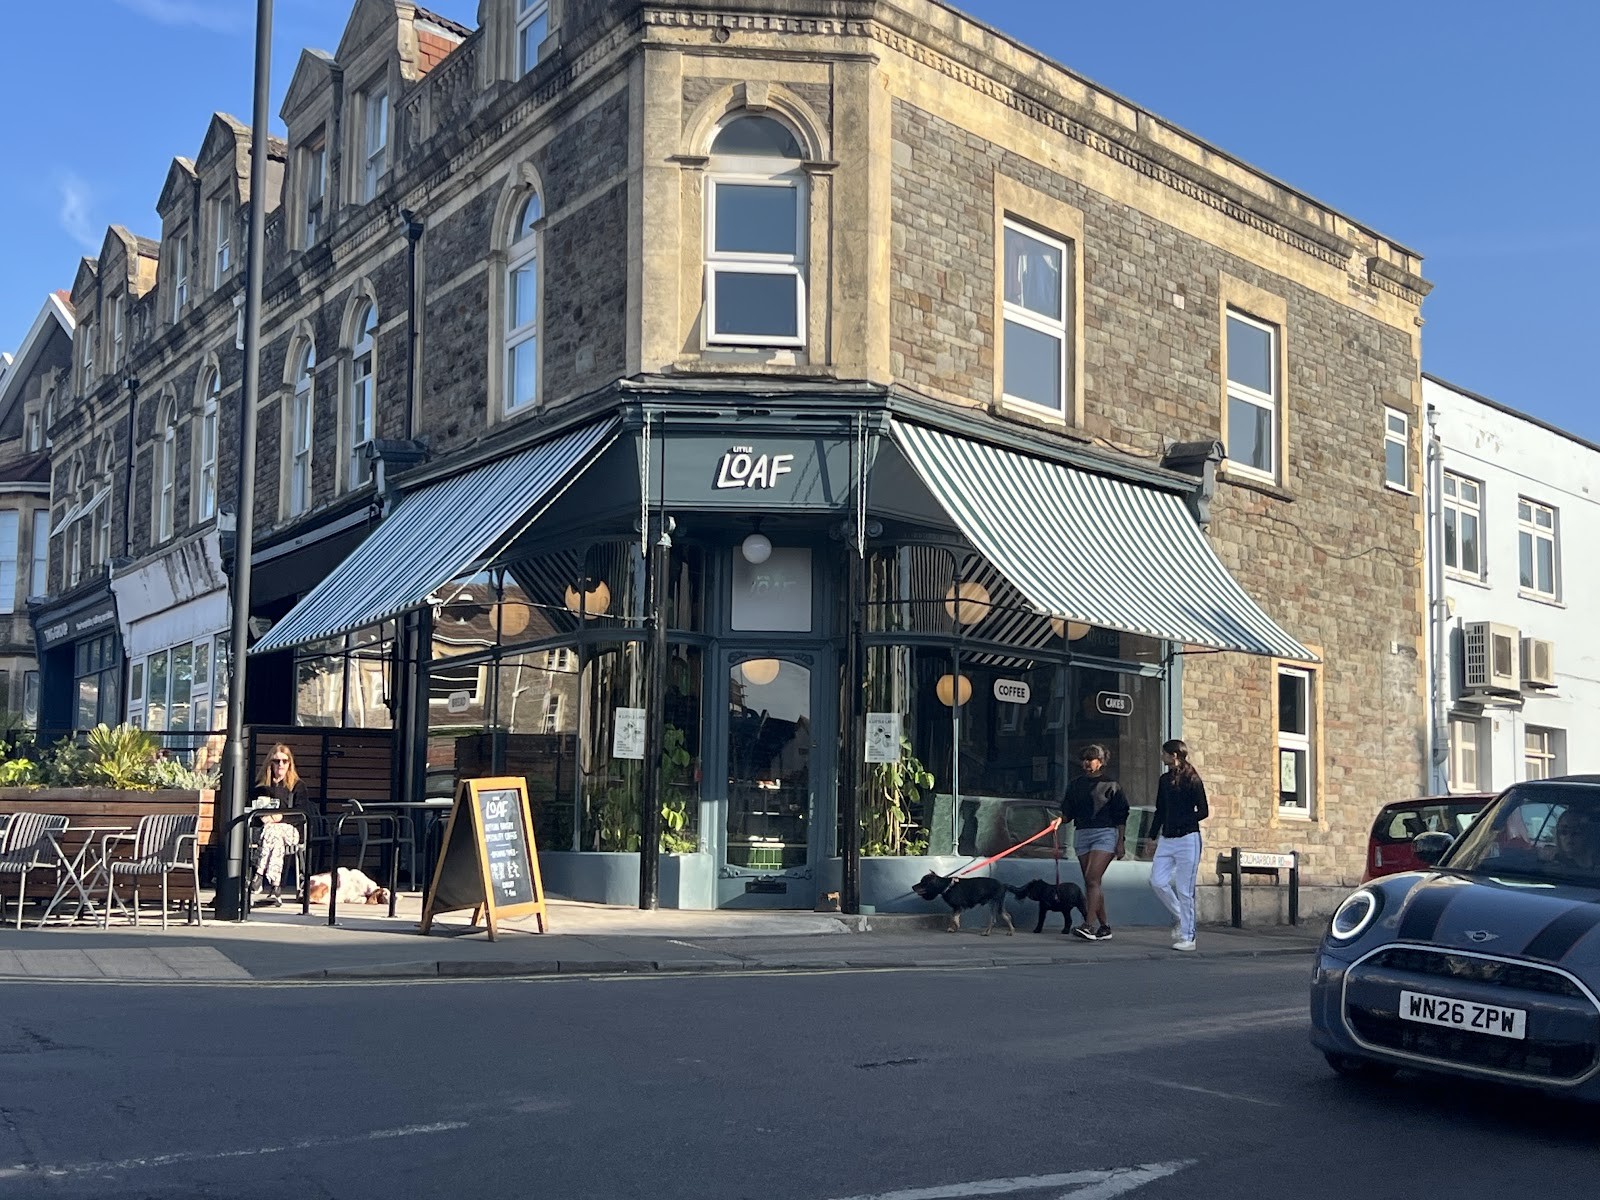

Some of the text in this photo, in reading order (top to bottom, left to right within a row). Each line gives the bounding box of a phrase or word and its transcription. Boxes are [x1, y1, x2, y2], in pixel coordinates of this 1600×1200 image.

[733, 446, 753, 454] LITTLE
[717, 453, 795, 488] LOAF
[998, 684, 1026, 699] COFFEE
[1105, 697, 1125, 710] CAKES
[486, 800, 509, 819] LOAF
[1409, 995, 1515, 1033] WN26 ZPW
